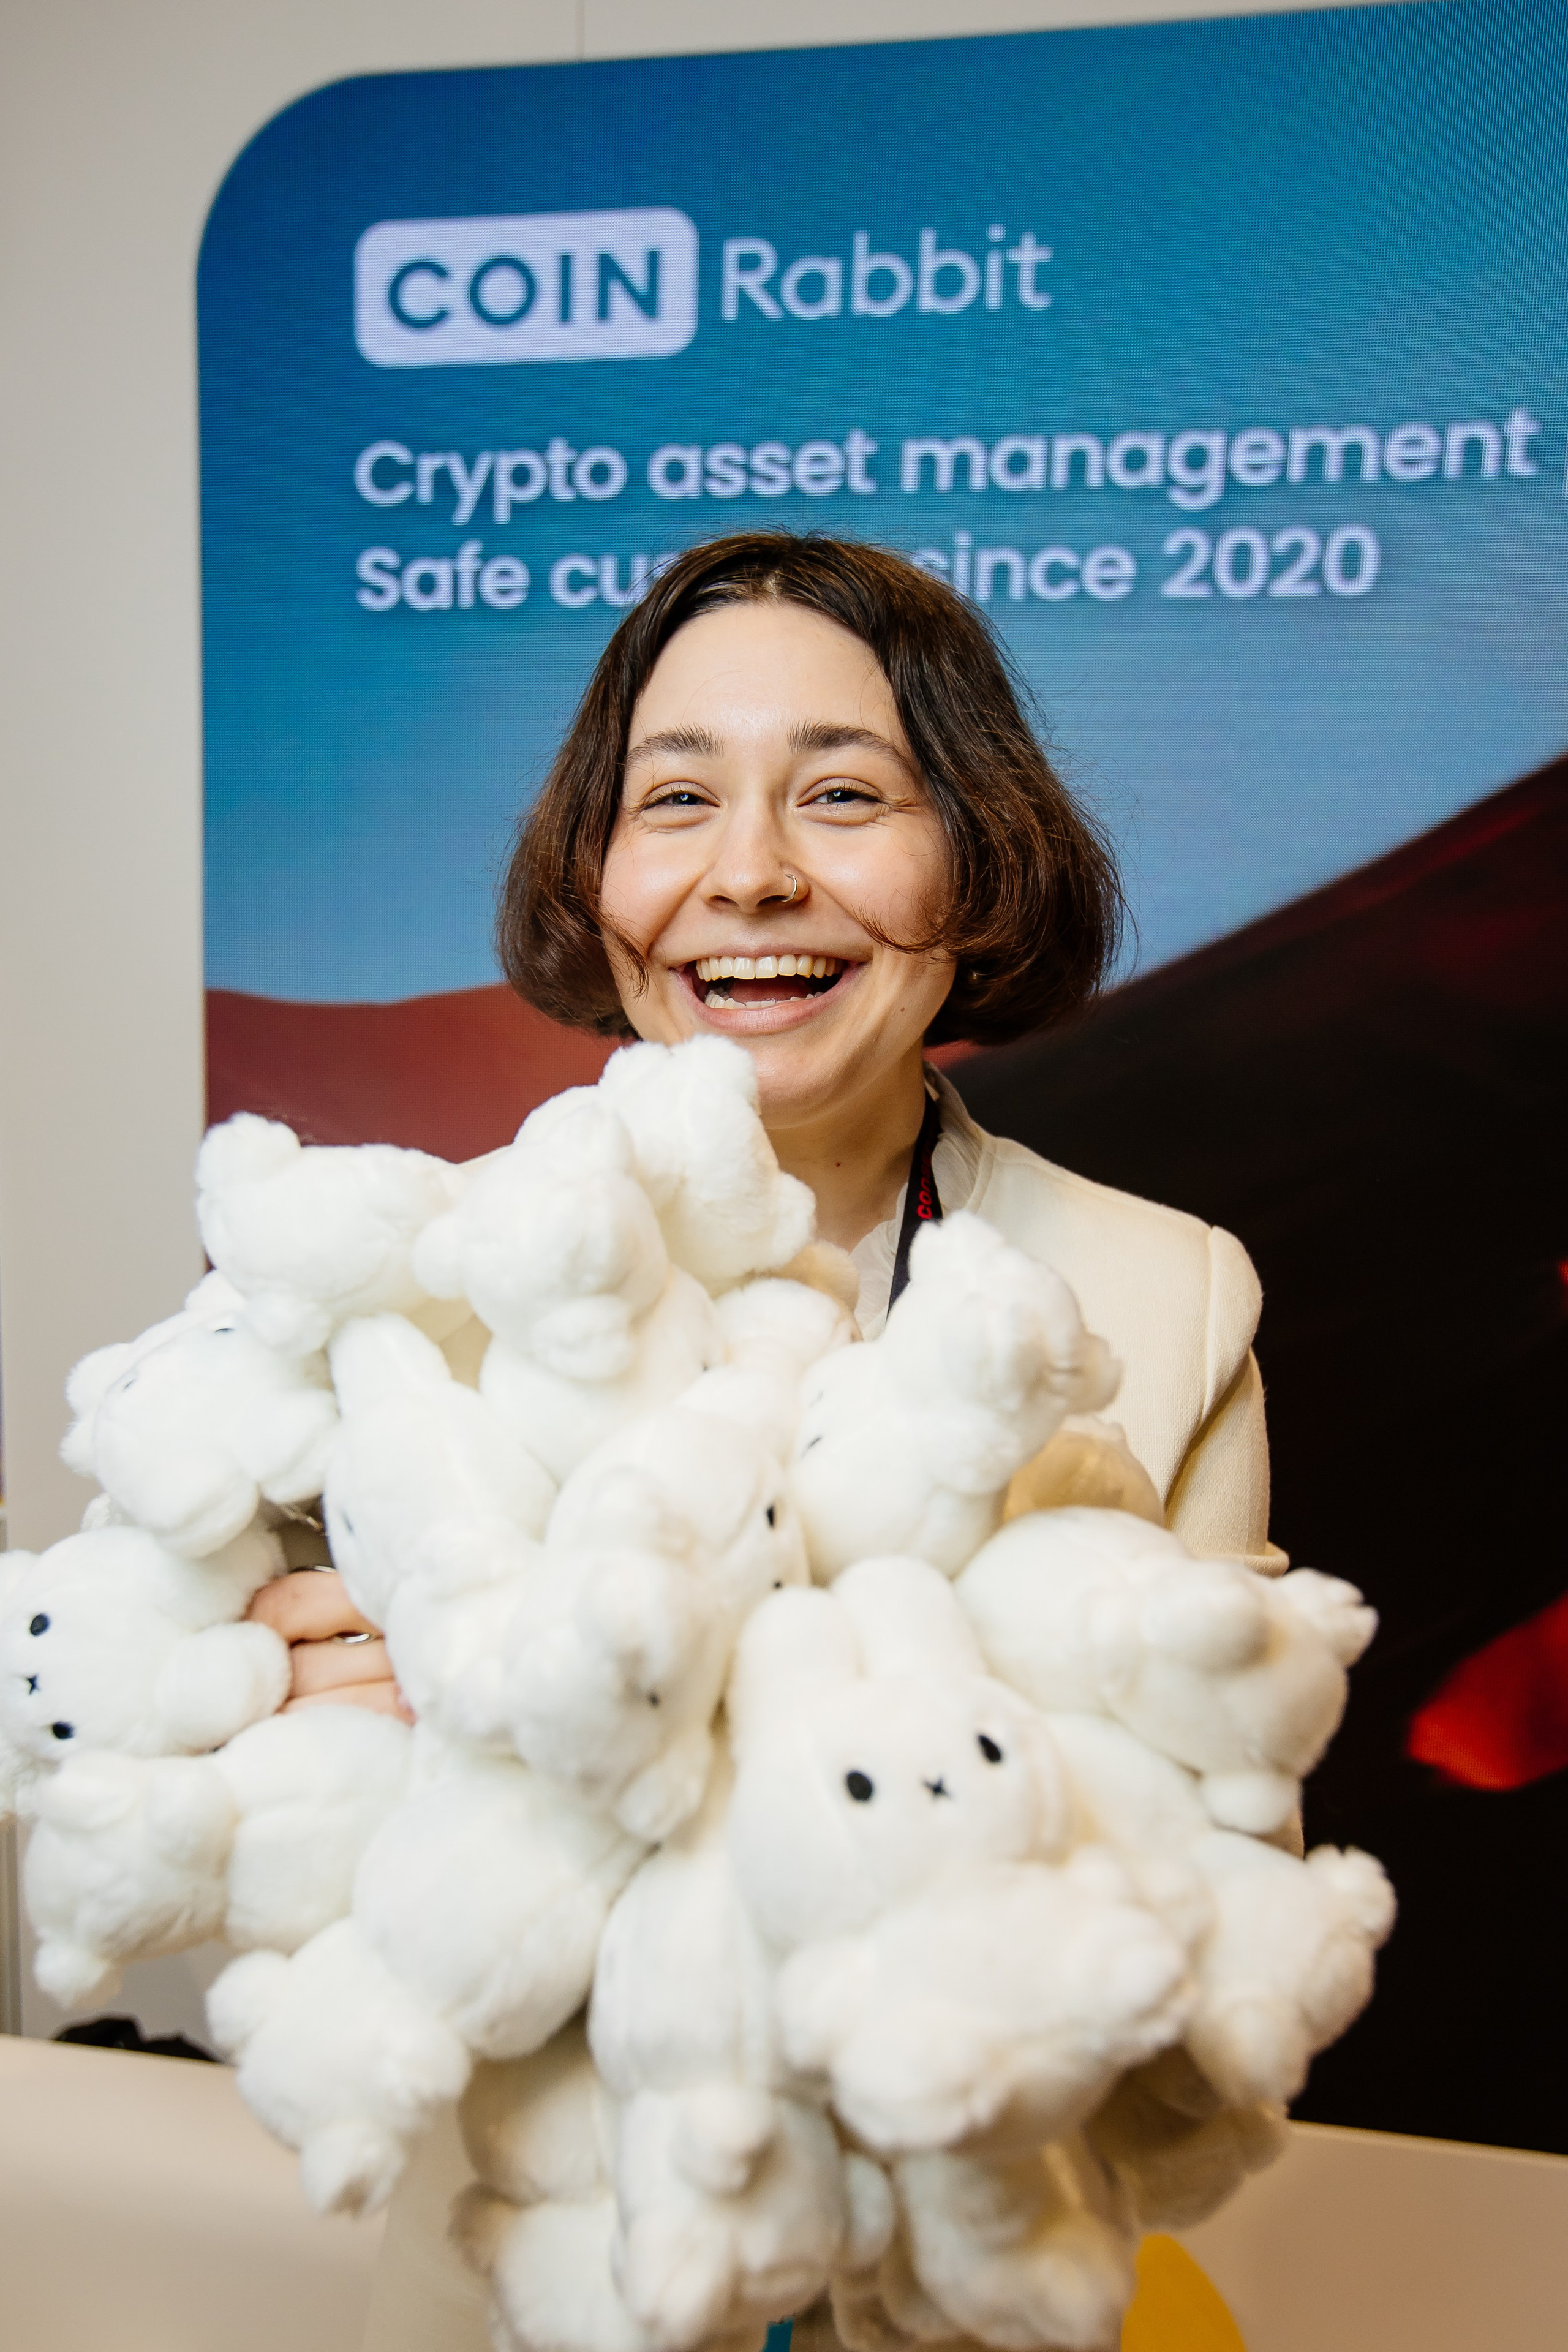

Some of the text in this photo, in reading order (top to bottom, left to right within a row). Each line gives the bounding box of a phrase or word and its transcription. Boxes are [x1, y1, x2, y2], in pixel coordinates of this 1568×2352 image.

[388, 225, 1052, 331] COIN Rabbit
[355, 437, 627, 524] Crypto
[647, 429, 878, 497] asset
[899, 407, 1542, 510] management
[356, 540, 529, 611] Safe
[1161, 526, 1381, 600] 2020
